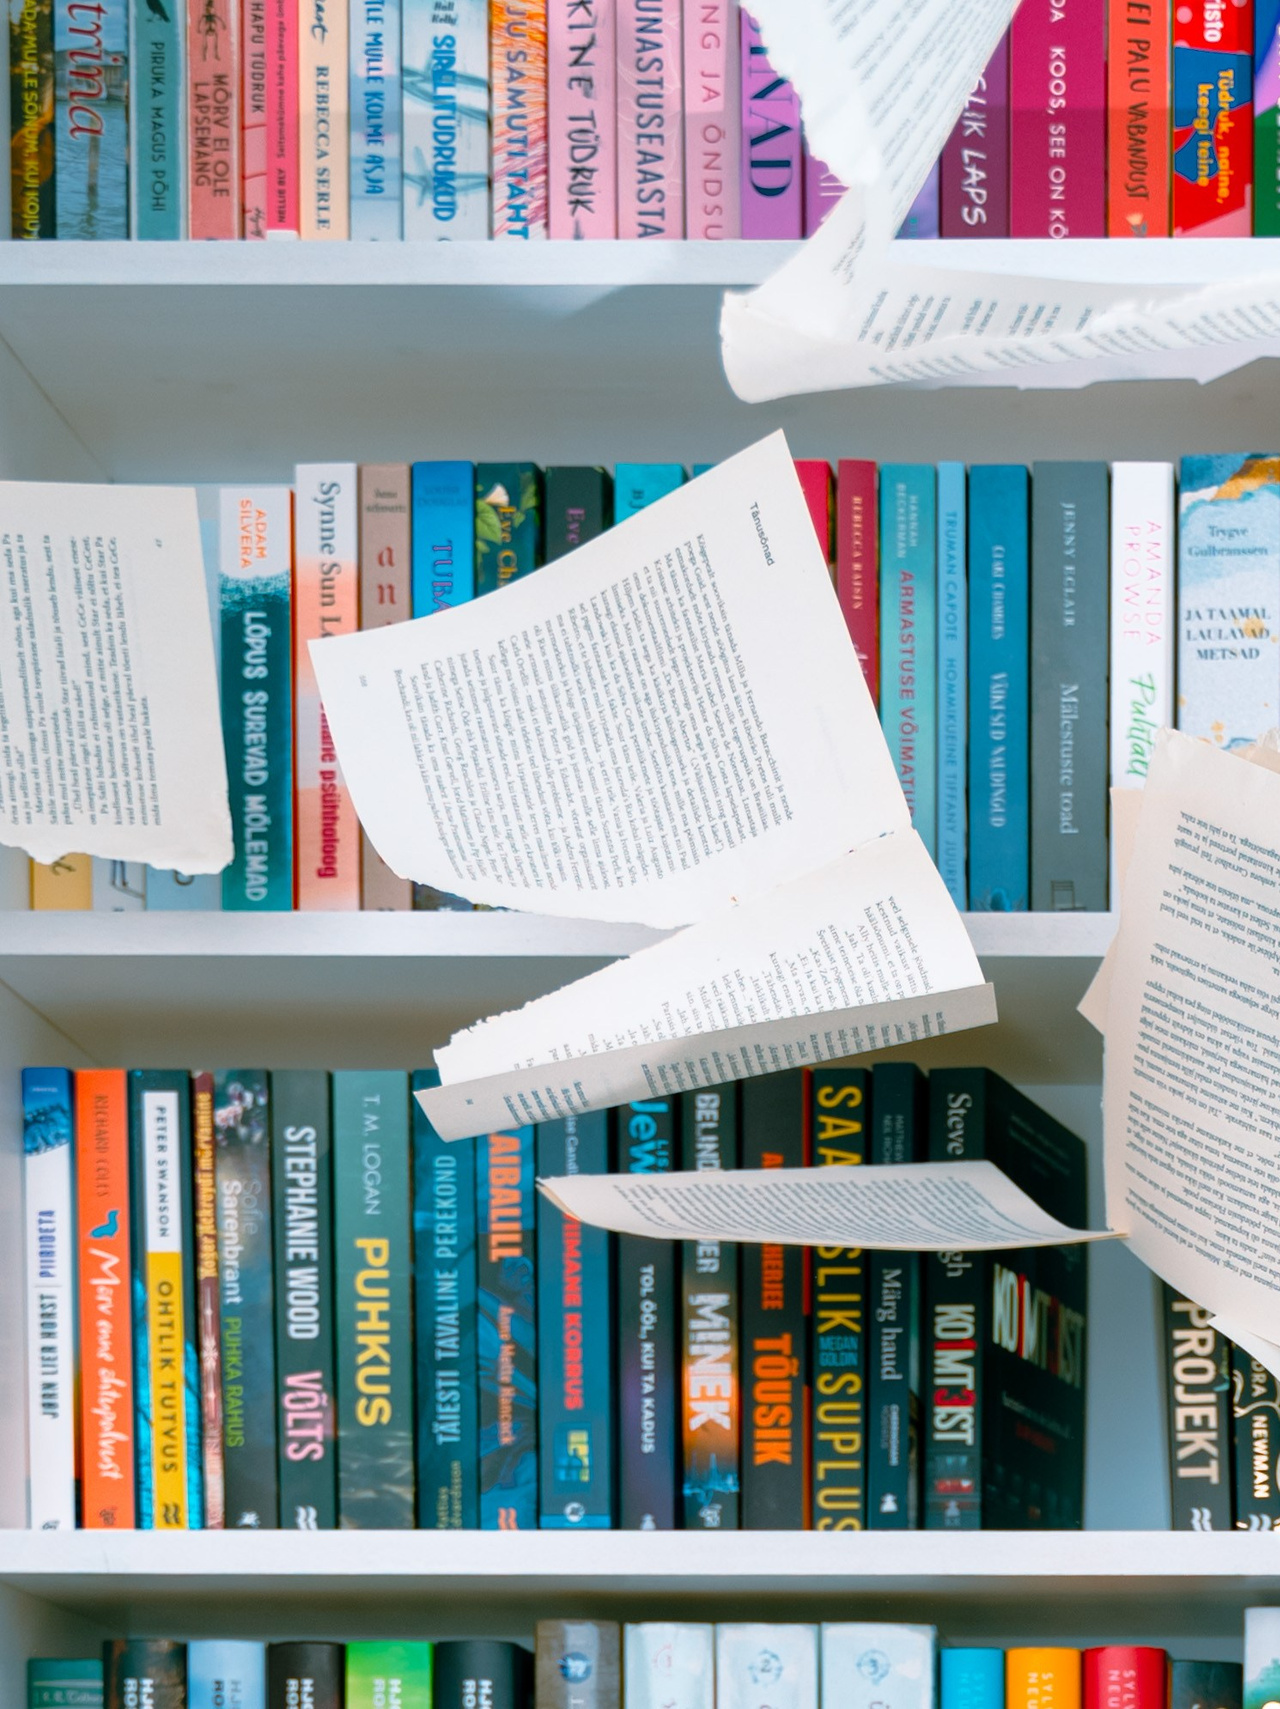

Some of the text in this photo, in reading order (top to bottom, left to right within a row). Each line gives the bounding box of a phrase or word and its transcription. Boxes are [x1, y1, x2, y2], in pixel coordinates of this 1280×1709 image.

[148, 42, 173, 213] PIRUKA MAGUS PÕHI
[212, 73, 233, 198] MÕRV EI OLE
[315, 65, 331, 231] REBECCA SERLE
[363, 33, 386, 195] MULLE KOLME ASJA
[432, 35, 462, 222] SIRELITÜDRUKUD
[1194, 83, 1217, 187] keegi teine
[1214, 69, 1235, 204] Tüdruk, naine,
[960, 147, 987, 227] LAPS
[240, 498, 253, 570] SILVERA
[254, 508, 267, 560] ADAM
[312, 482, 341, 606] Synne Sun
[749, 501, 775, 567] Tänusõnad
[945, 510, 959, 642] TRUMAN CAPOTE
[1061, 502, 1078, 628] JENNY ECLAIR
[1123, 525, 1142, 640] PROWSE
[1144, 518, 1163, 648] AMANDA
[900, 569, 917, 701] ARMASTUSE
[1196, 649, 1260, 661] METSAD
[243, 611, 270, 902] LÕPUS SUREVAD MÕLEMAD
[1059, 682, 1081, 835] Mälestuste toad
[315, 769, 339, 881] psühholoog
[155, 1105, 171, 1238] PETER SWANSON
[945, 1092, 973, 1156] Steve
[221, 1179, 243, 1305] Sarenbrant
[283, 1126, 321, 1340] STEPHANIE WOOD
[88, 1248, 128, 1480] Mõrv enne õhtupalvust
[354, 1237, 391, 1427] PUHKUS
[432, 1155, 462, 1445] TÄIESTI TAVALINE PEREKOND
[563, 1312, 584, 1410] KORRUS
[638, 1264, 658, 1454] TOL ÖÖL, KUI TA KADUS
[686, 1292, 732, 1432] MINEK
[876, 1268, 905, 1380] Märg haud
[157, 1280, 179, 1474] OHTLIK TUTVUS
[223, 1315, 244, 1447] PUHKA RAHUS
[281, 1370, 328, 1461] VÕLTS
[752, 1333, 800, 1465] TÕUSIK
[1171, 1300, 1220, 1485] PROJEKT
[1251, 1414, 1271, 1499] NEWMAN
